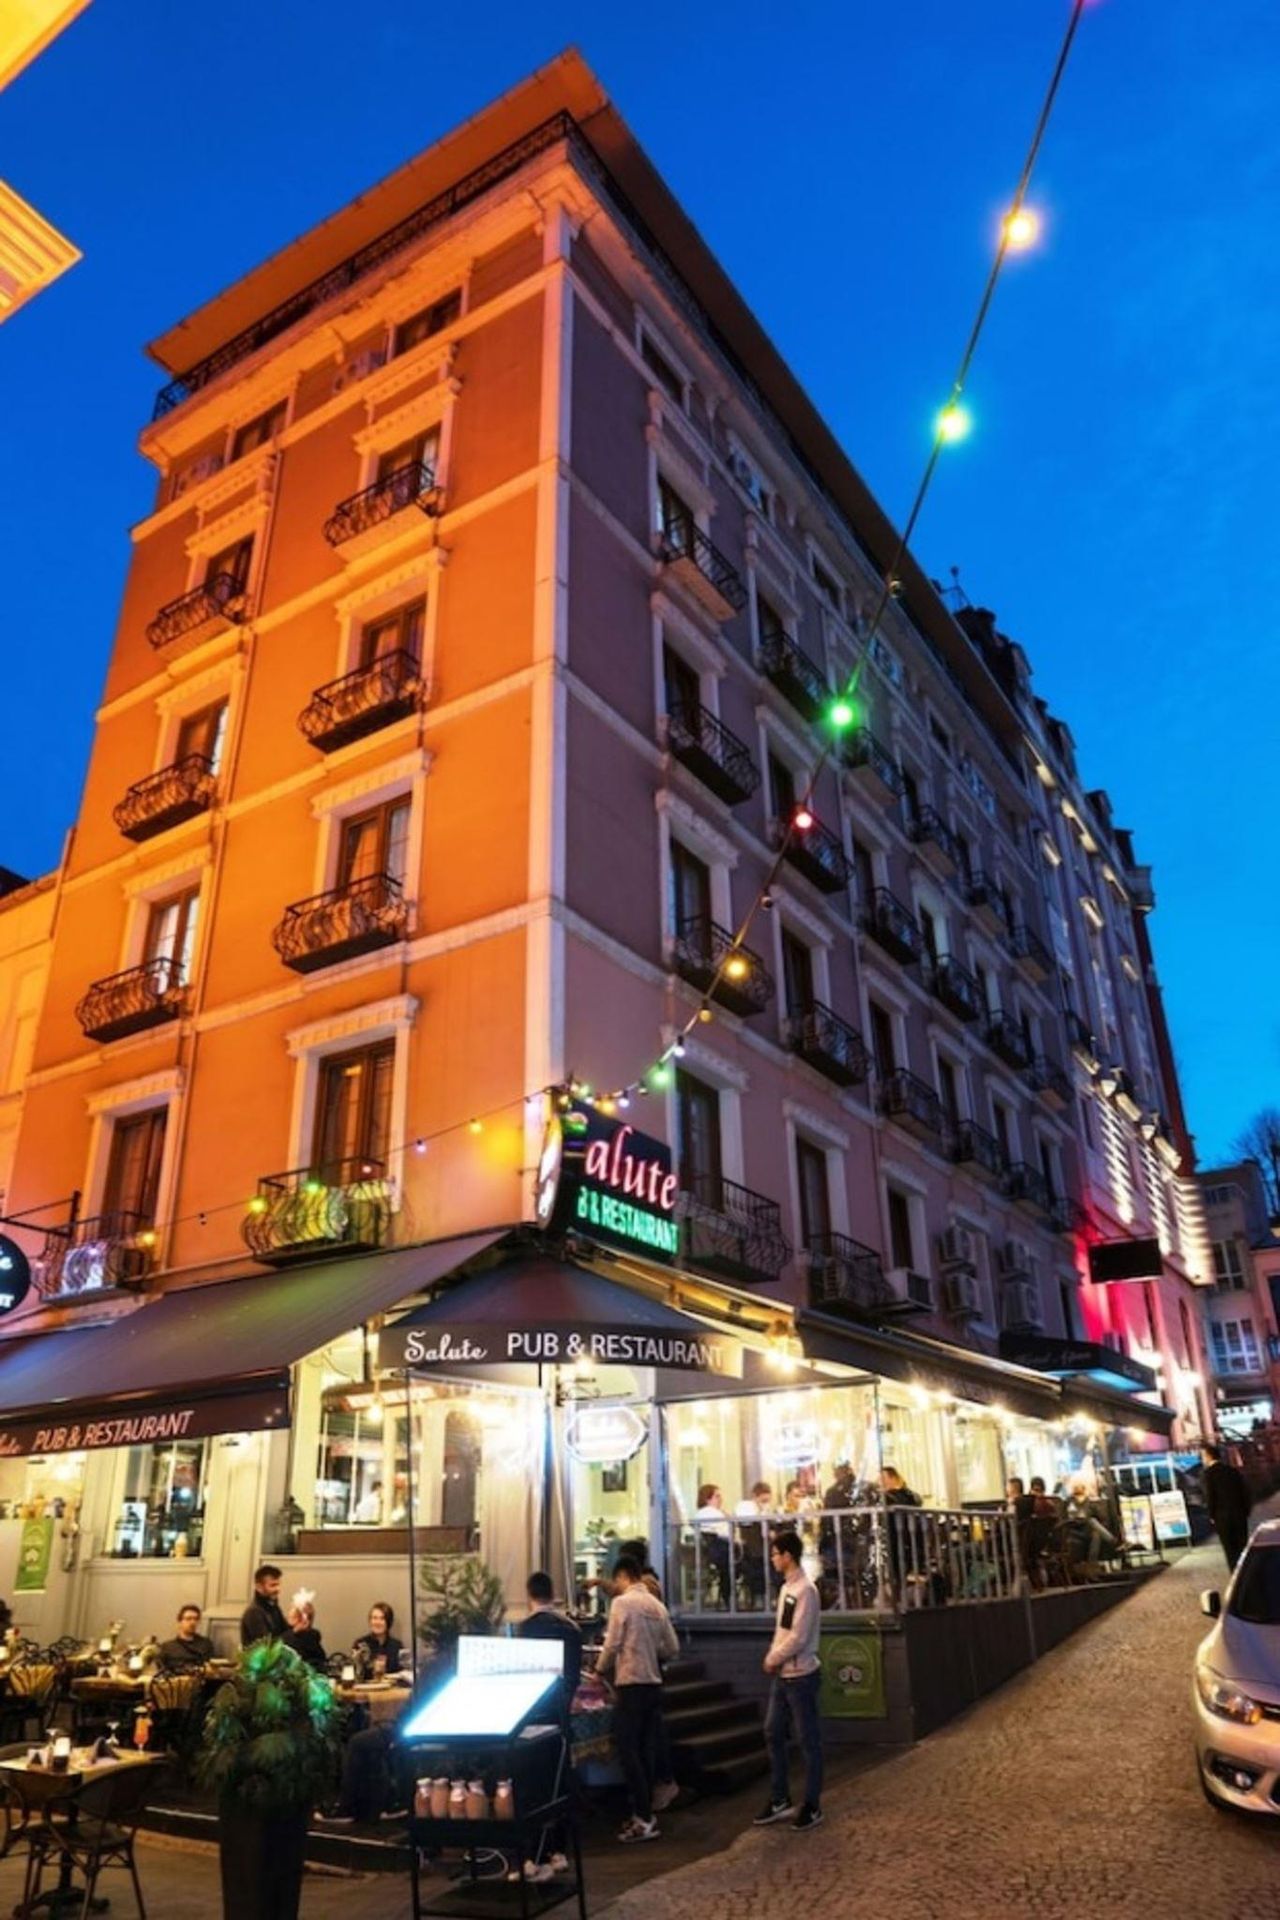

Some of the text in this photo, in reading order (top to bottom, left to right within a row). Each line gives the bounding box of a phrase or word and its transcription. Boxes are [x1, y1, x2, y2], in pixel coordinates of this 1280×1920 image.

[585, 1126, 677, 1209] alute
[602, 1194, 678, 1254] RESTAURANT
[404, 1331, 724, 1370] Salute PUB & RESTAURANT
[31, 1427, 67, 1451] PUB
[82, 1410, 194, 1447] RESTAURANT
